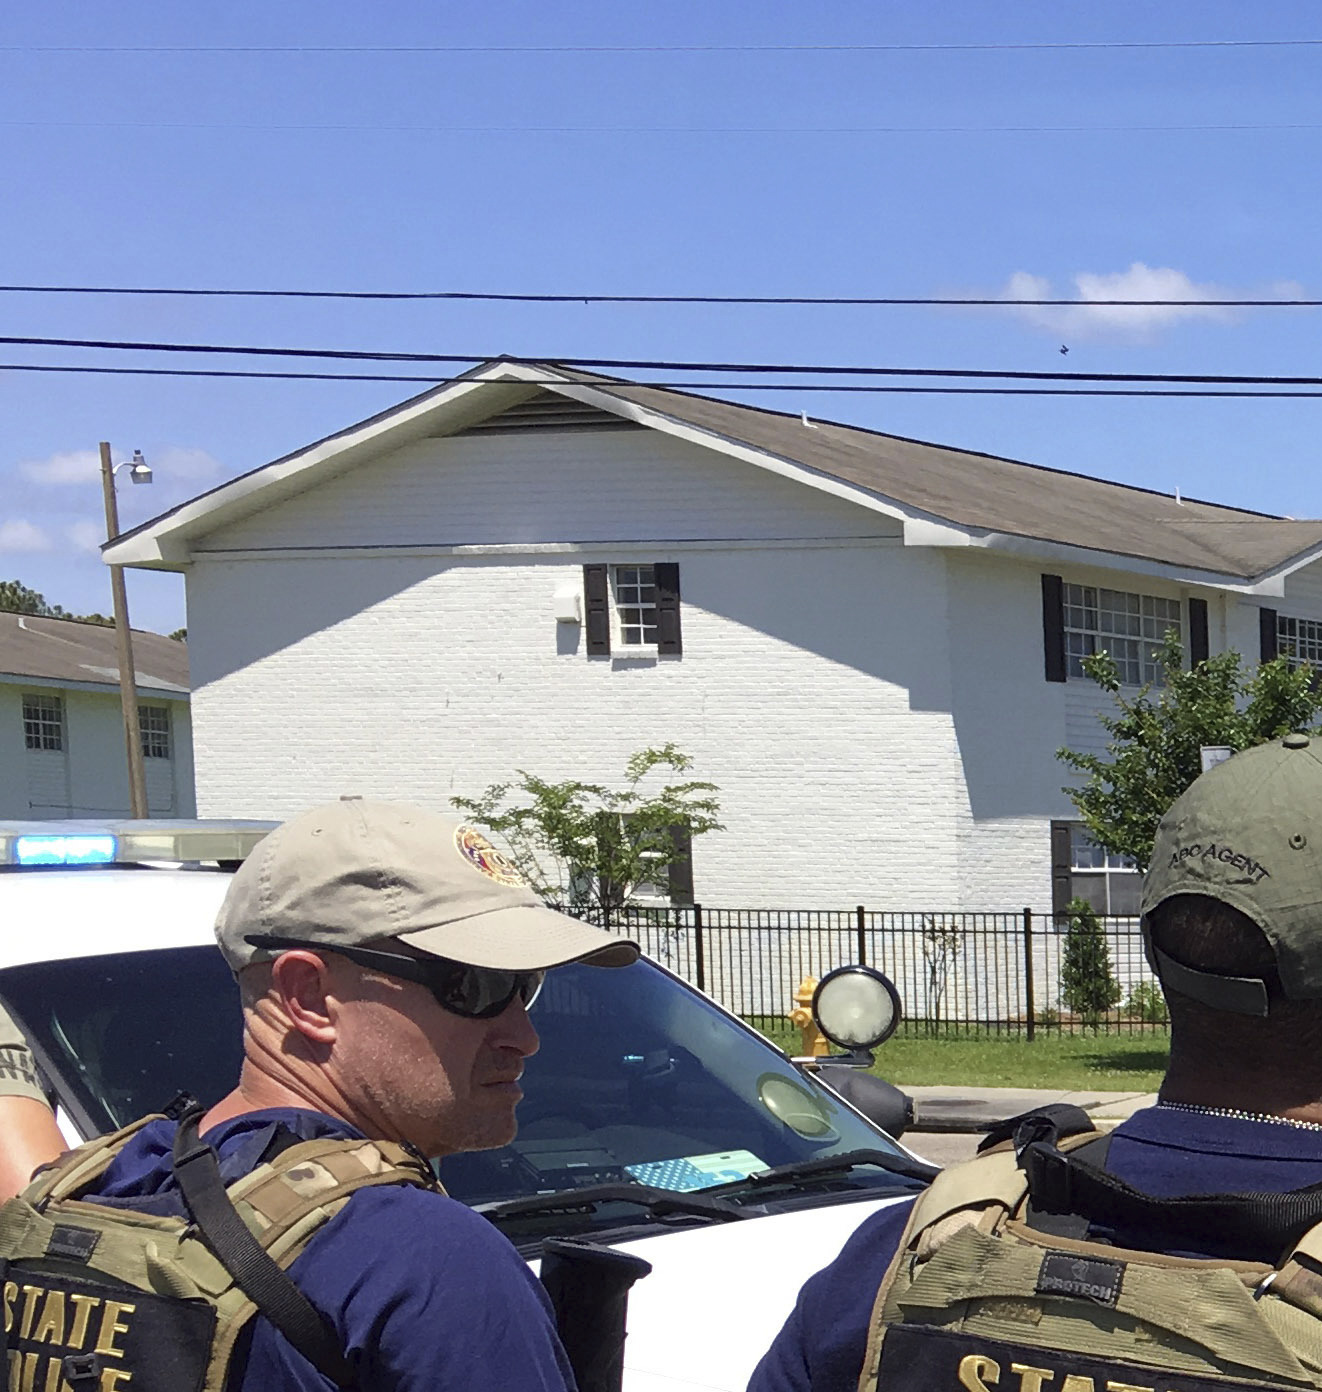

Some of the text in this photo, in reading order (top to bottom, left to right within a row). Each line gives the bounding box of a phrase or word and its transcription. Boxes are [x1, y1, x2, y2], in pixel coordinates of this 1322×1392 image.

[1167, 842, 1271, 883] ABC AGENT
[1040, 1276, 1112, 1300] PROTECH
[4, 1281, 136, 1358] STATE
